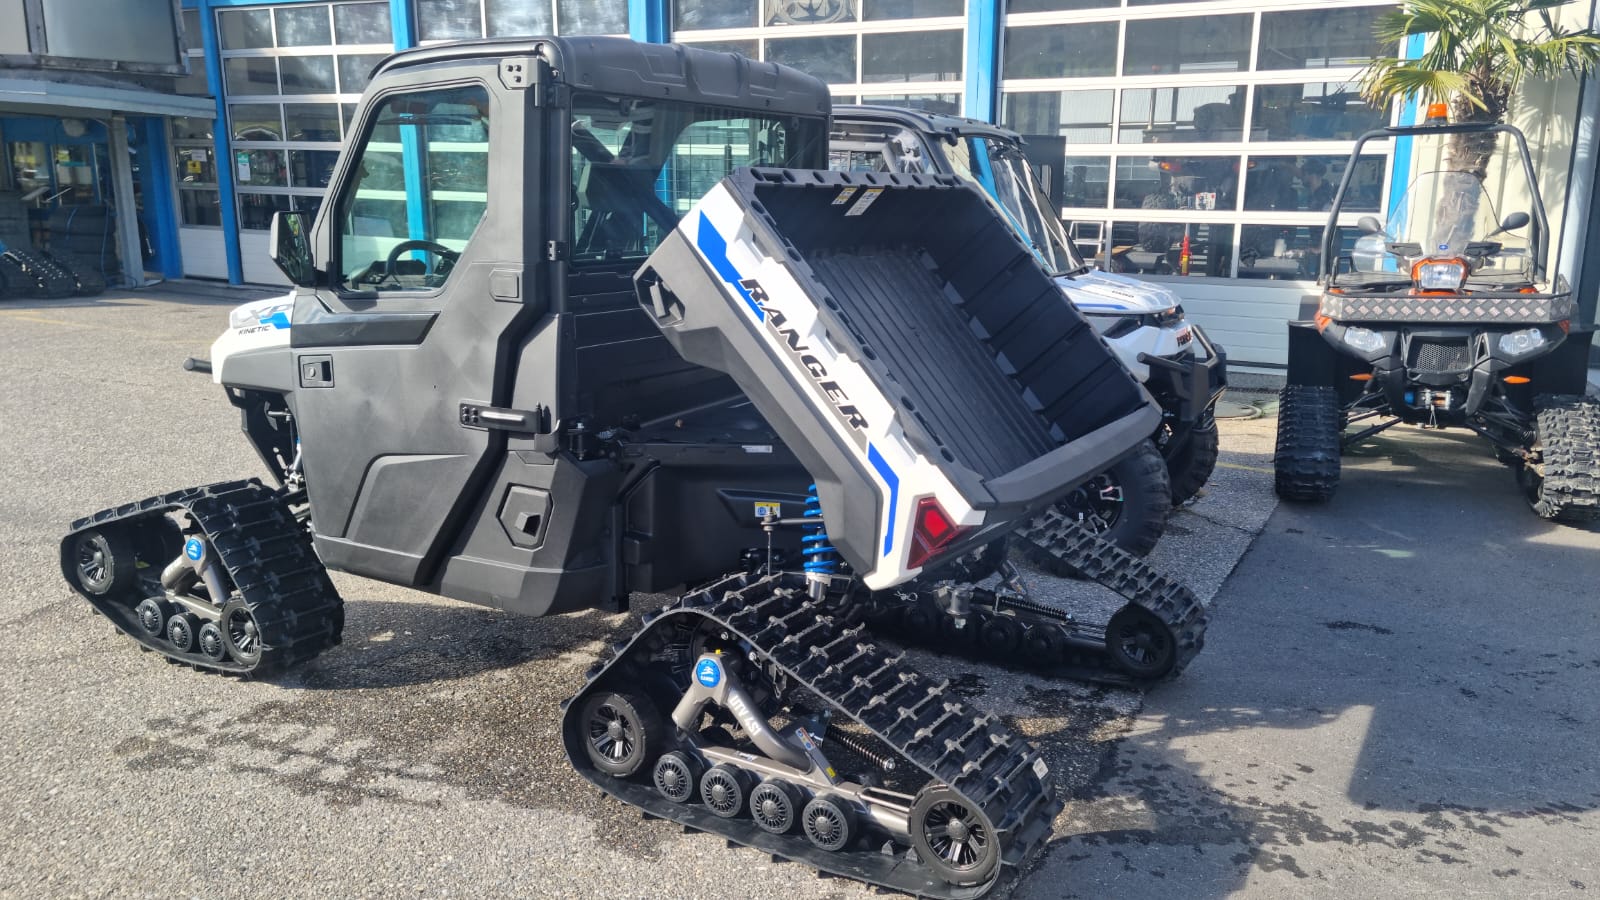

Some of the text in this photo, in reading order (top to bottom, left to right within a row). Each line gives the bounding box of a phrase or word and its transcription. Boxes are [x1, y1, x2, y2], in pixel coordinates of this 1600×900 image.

[238, 325, 271, 336] KINETIC
[739, 279, 869, 430] RANGER
[729, 695, 749, 717] UTV
